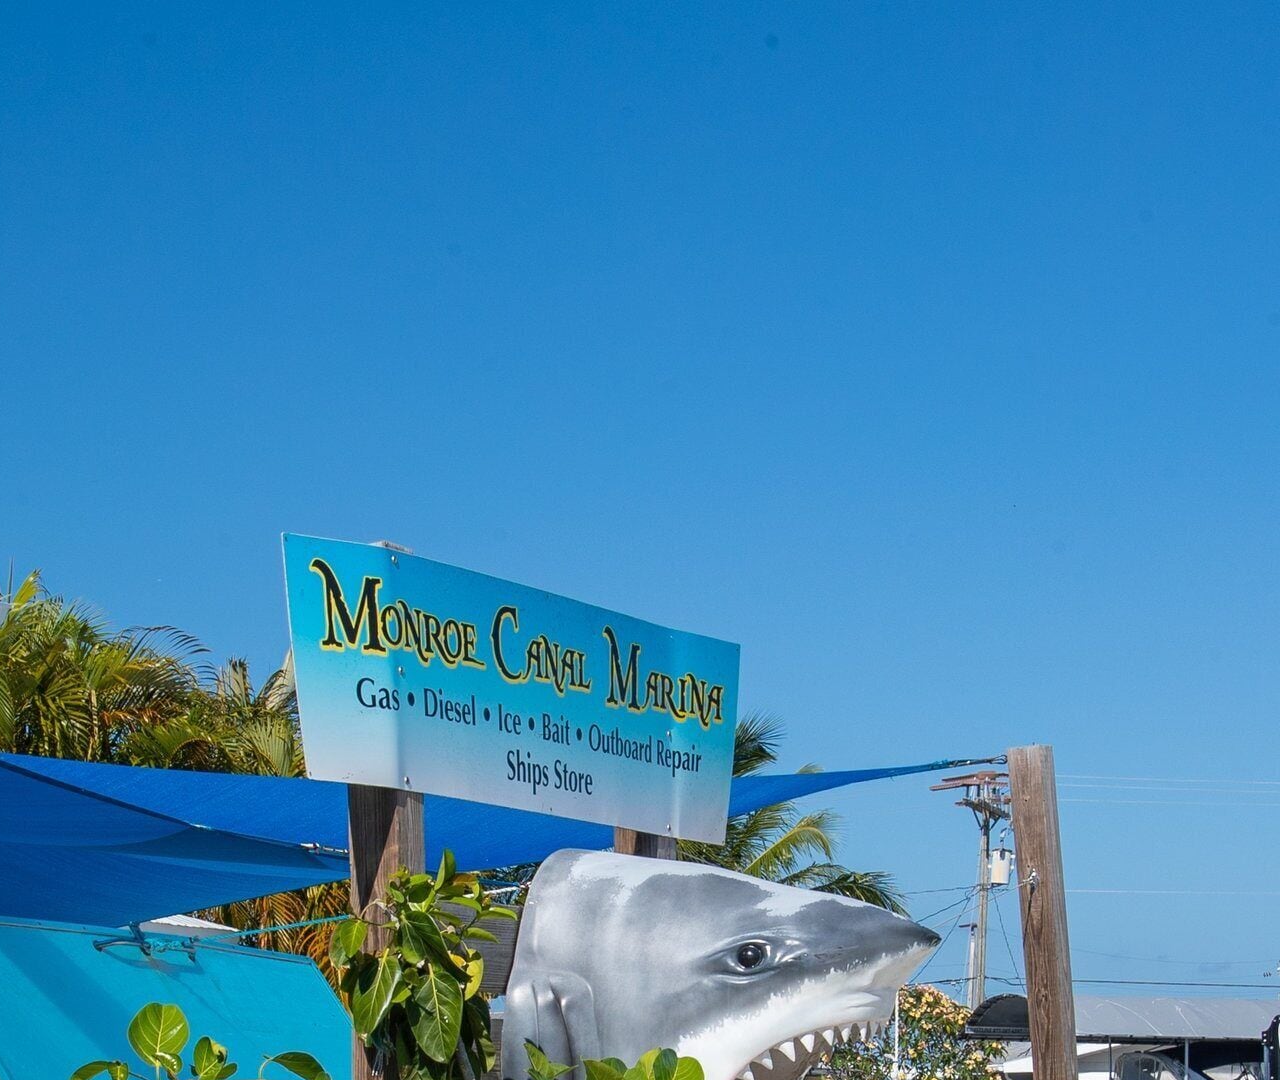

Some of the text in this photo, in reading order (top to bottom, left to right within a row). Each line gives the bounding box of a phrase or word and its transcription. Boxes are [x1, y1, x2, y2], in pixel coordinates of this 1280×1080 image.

[356, 677, 702, 777] Gas Diesel Ice Bait Outboard Repair
[507, 750, 593, 796] Ships Store
